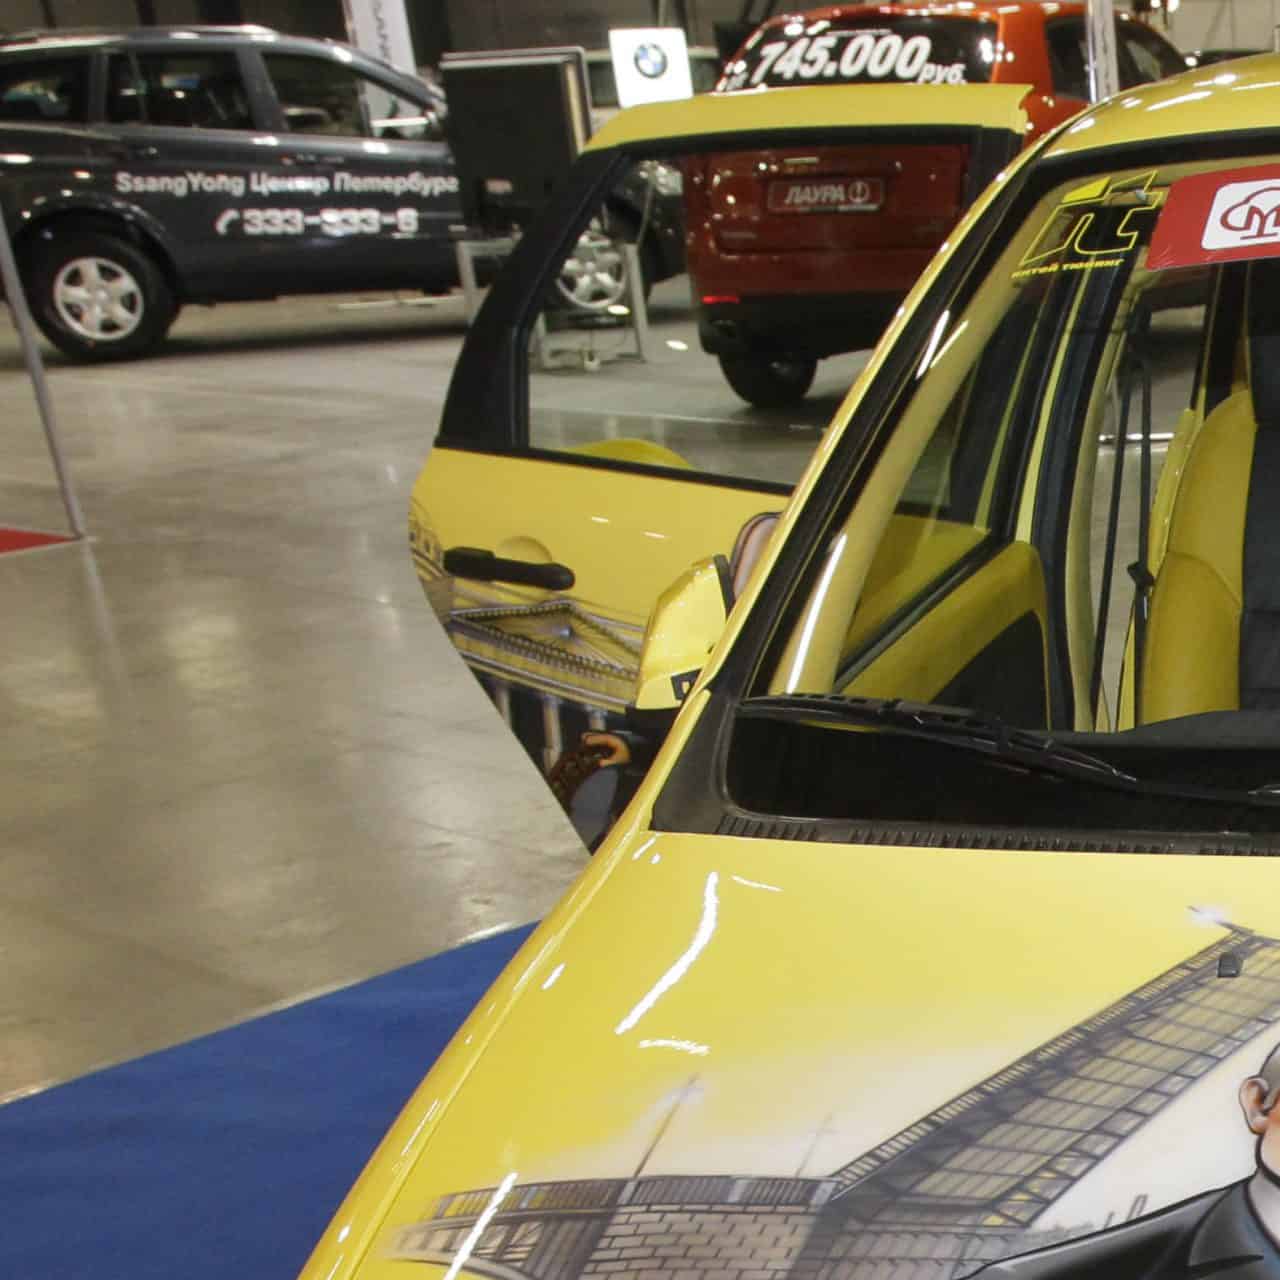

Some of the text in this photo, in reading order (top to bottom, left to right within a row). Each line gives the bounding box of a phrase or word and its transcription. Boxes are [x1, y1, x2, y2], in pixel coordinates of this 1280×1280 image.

[750, 34, 932, 85] 745.000
[917, 62, 968, 84] руб.
[115, 171, 246, 197] SsangYong
[785, 184, 846, 205] ЛАУРА
